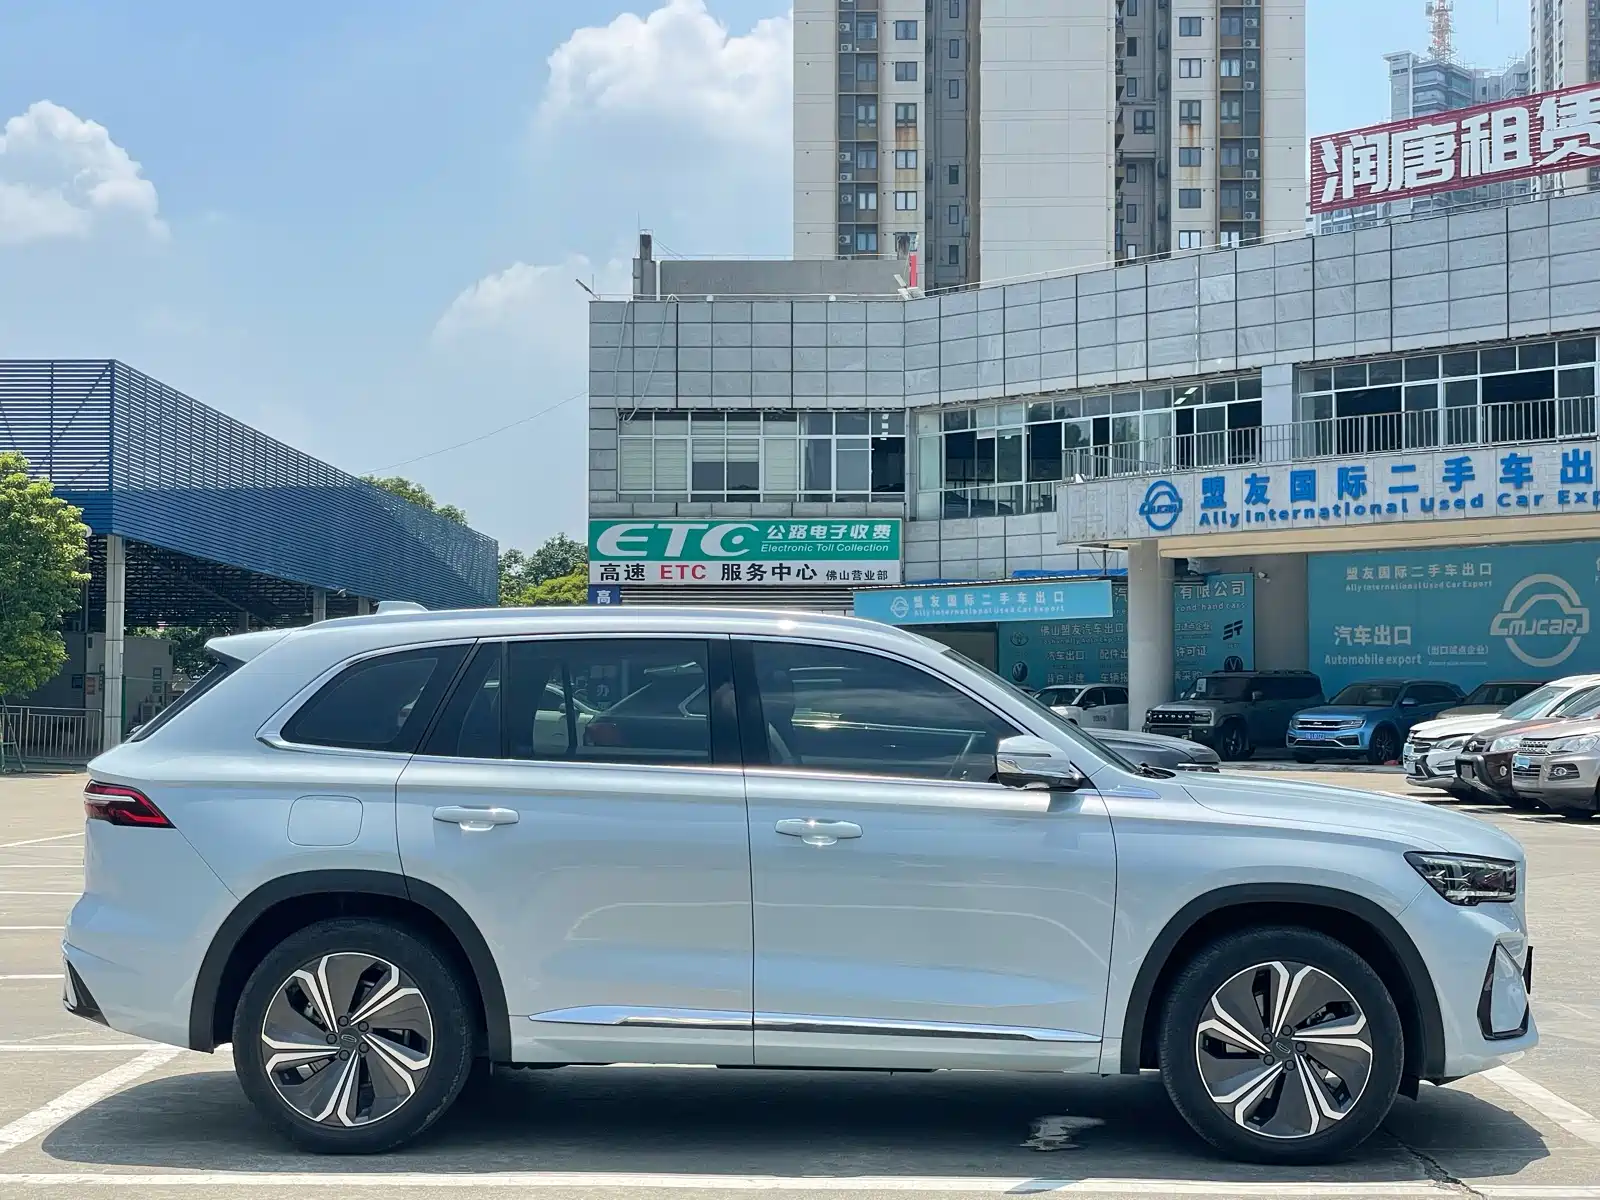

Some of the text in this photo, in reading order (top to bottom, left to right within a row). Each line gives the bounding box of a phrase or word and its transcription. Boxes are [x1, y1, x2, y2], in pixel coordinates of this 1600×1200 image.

[1320, 89, 1600, 204] 润唐租赁
[1200, 448, 1593, 510] 盟友国际二手车出
[1200, 510, 1240, 528] Ally
[1246, 498, 1408, 523] International
[1420, 493, 1484, 513] Used
[1497, 492, 1545, 509] Car
[596, 523, 760, 557] ETC
[767, 524, 892, 539] 公路电子收费
[760, 543, 889, 553] Electronic Toll Collection
[599, 563, 889, 582] 高速 ETC 服务中心 佛山营业部
[1345, 562, 1493, 580] 盟友国际二手车出口
[596, 589, 611, 604] 高
[913, 590, 1065, 609] 盟友国际二手车出口
[1334, 625, 1412, 646] 汽车出口
[1324, 652, 1384, 665] Automobile
[1385, 653, 1422, 666] export
